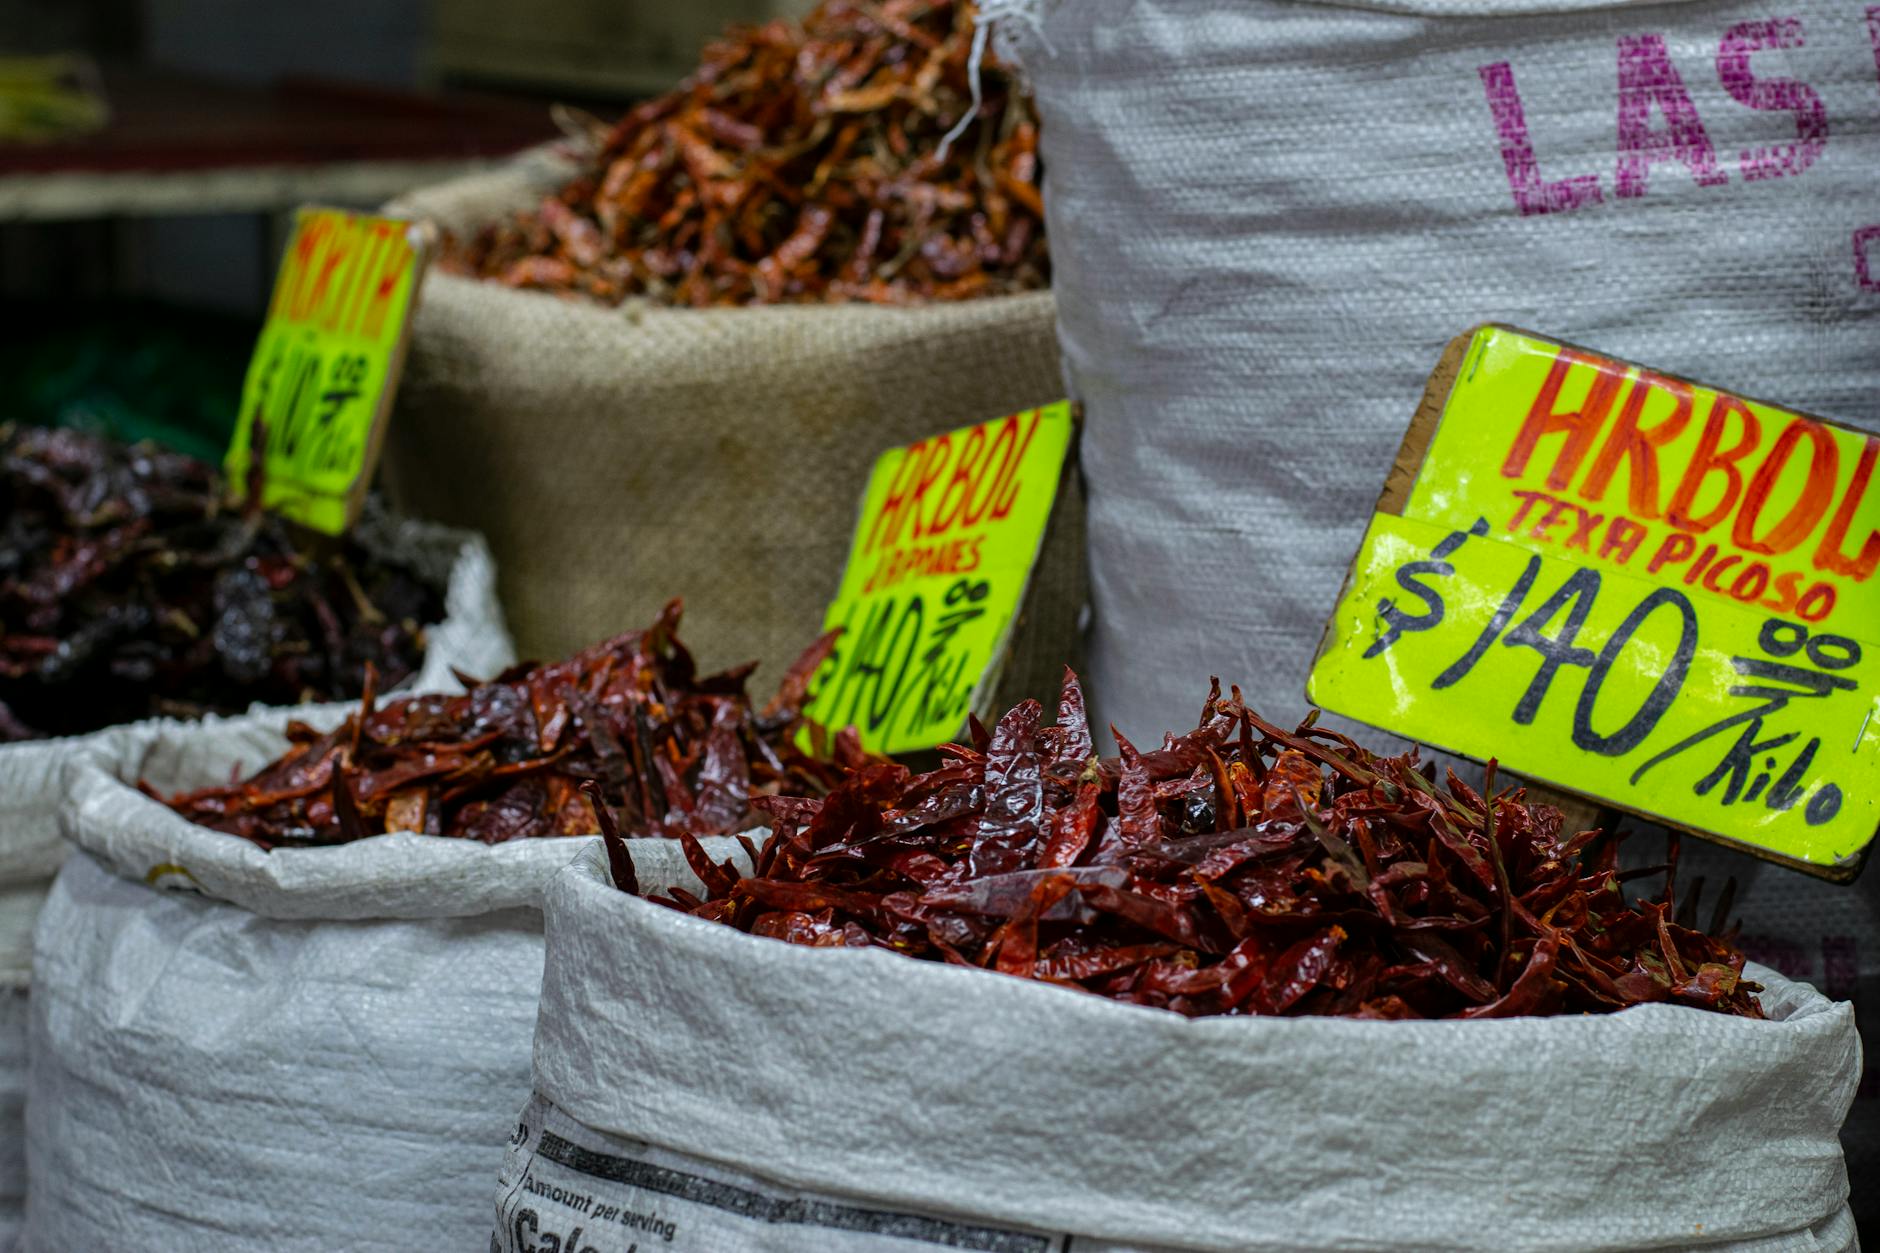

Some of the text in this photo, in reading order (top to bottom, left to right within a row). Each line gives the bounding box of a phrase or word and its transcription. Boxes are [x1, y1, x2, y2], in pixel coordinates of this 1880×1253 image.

[1478, 16, 1829, 217] LAS
[1512, 490, 1837, 623] TEXA PICOSO
[523, 1174, 593, 1214] Amount
[590, 1203, 620, 1222] per
